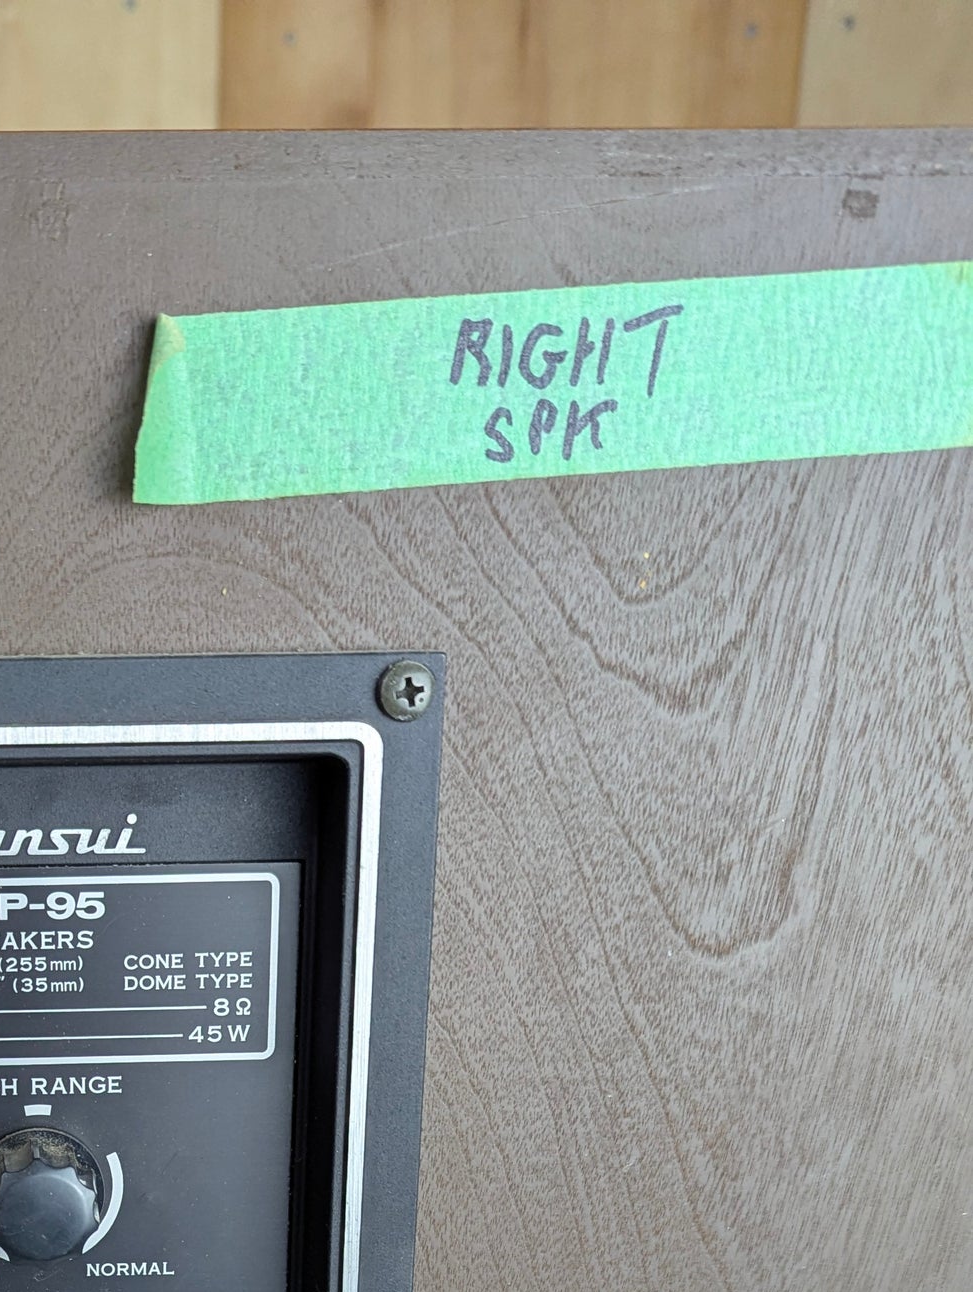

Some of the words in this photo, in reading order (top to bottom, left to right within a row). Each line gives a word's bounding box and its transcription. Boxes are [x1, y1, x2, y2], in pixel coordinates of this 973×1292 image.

[449, 304, 684, 398] RIGHT
[484, 398, 618, 463] SPK
[123, 953, 184, 971] CONE
[195, 951, 253, 969] TYPE
[123, 974, 184, 991] DOME
[195, 972, 253, 989] TYPE
[30, 1076, 123, 1096] RANGE
[86, 1261, 175, 1277] NORMAL
